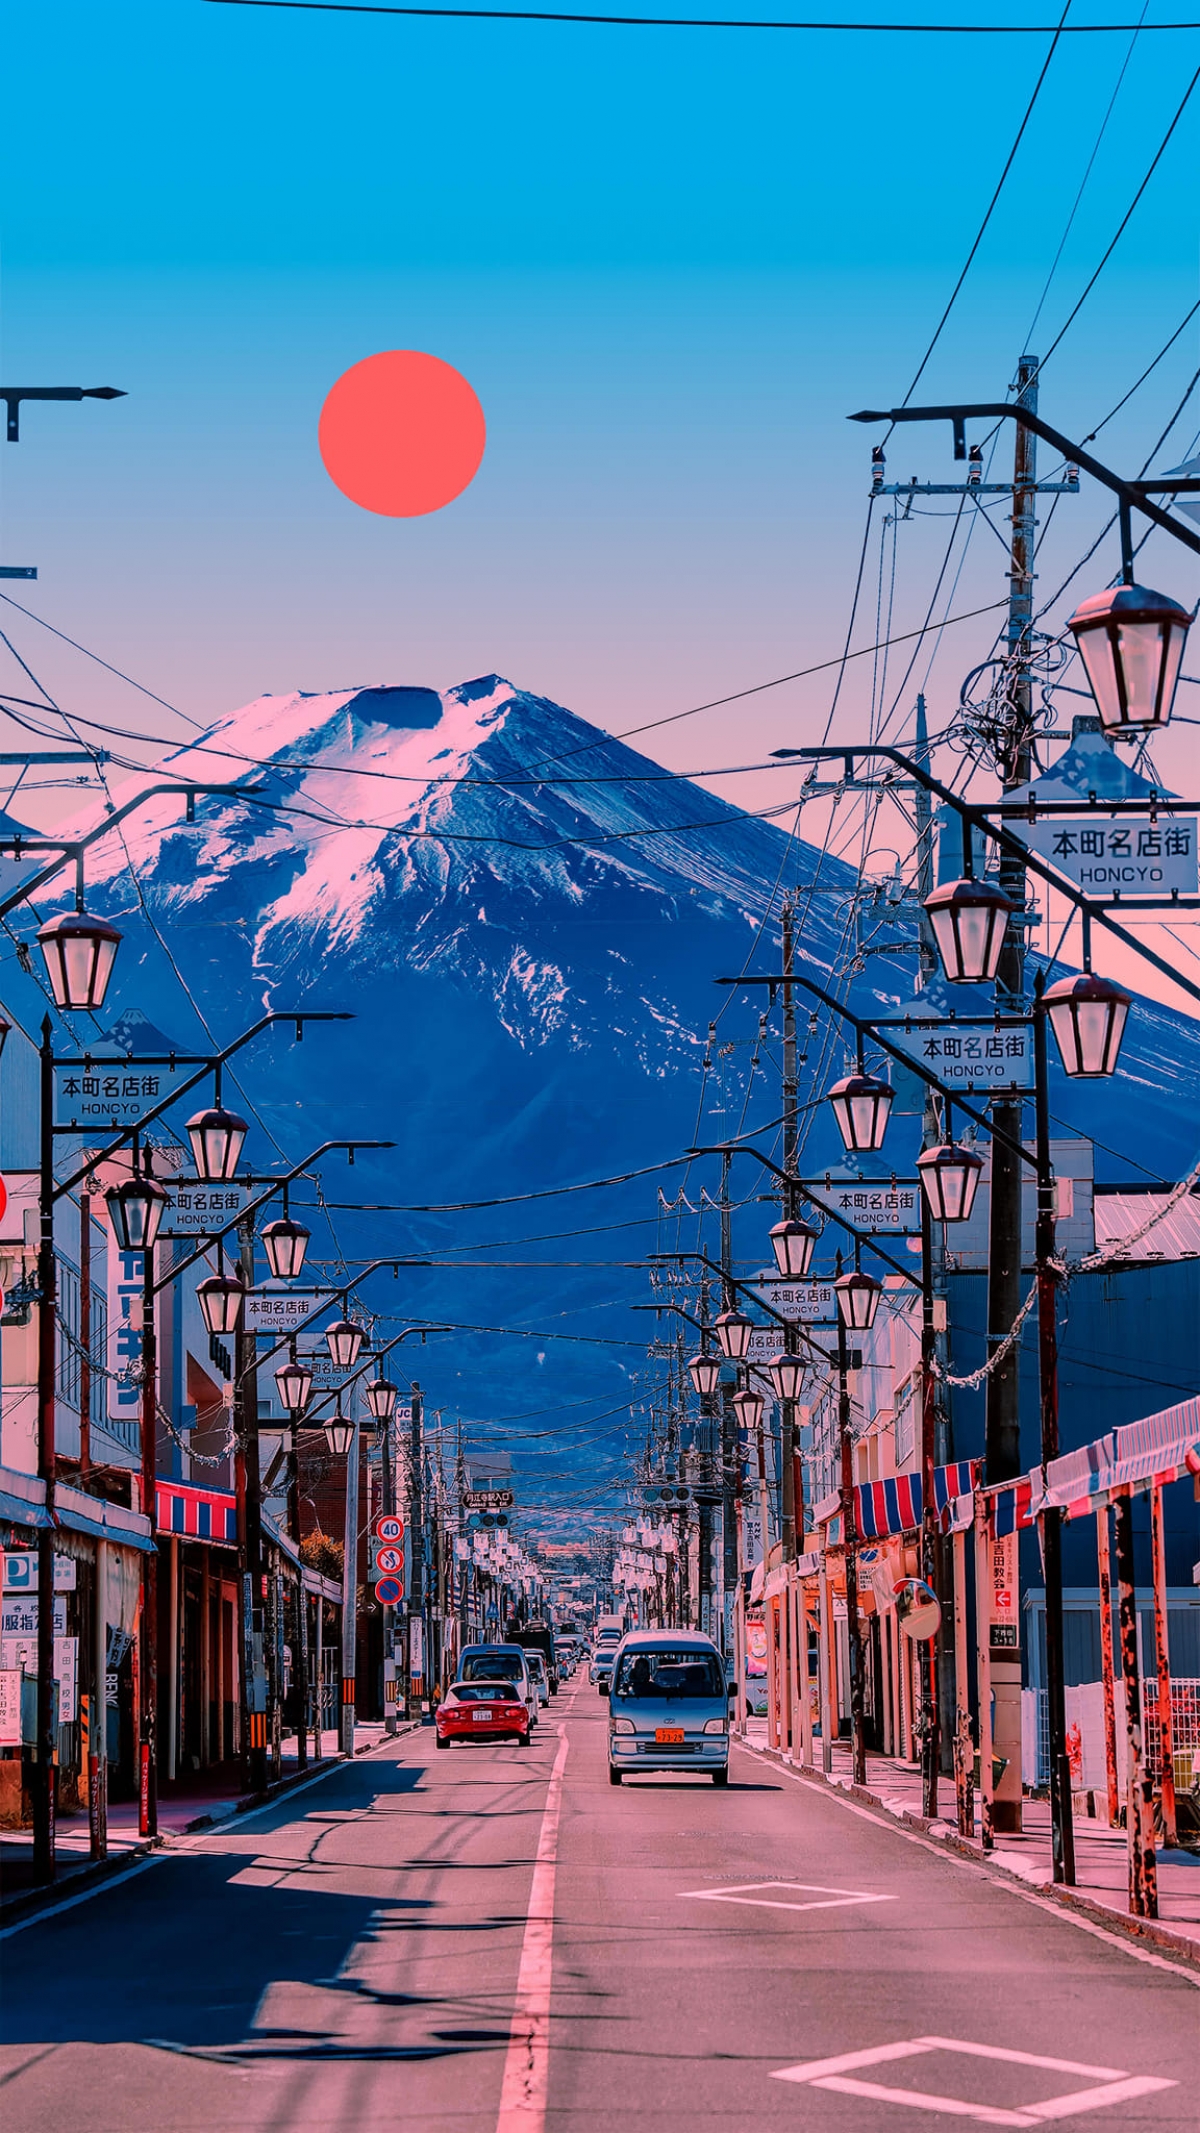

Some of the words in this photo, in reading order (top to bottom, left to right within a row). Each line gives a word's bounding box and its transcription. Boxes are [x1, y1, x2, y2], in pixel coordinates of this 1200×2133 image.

[1052, 828, 1191, 860] 本町名店街
[1080, 867, 1163, 882] HONCYO
[923, 1035, 1025, 1060] 本町名店街
[943, 1065, 1005, 1077] HONCYO
[62, 1076, 160, 1098] 本町名店街
[81, 1103, 141, 1115] HONCYO
[164, 1193, 240, 1210] 本町名店街
[839, 1193, 914, 1210] 本町名店街
[176, 1214, 225, 1224] HONCYO
[853, 1214, 900, 1223] HONCYO
[770, 1288, 831, 1303] 本町名店街
[249, 1301, 309, 1314] 本町名店街
[782, 1306, 820, 1314] HONCYO
[260, 1317, 298, 1326] HONCYO
[383, 1523, 399, 1536] 40
[4, 1558, 28, 1587] P
